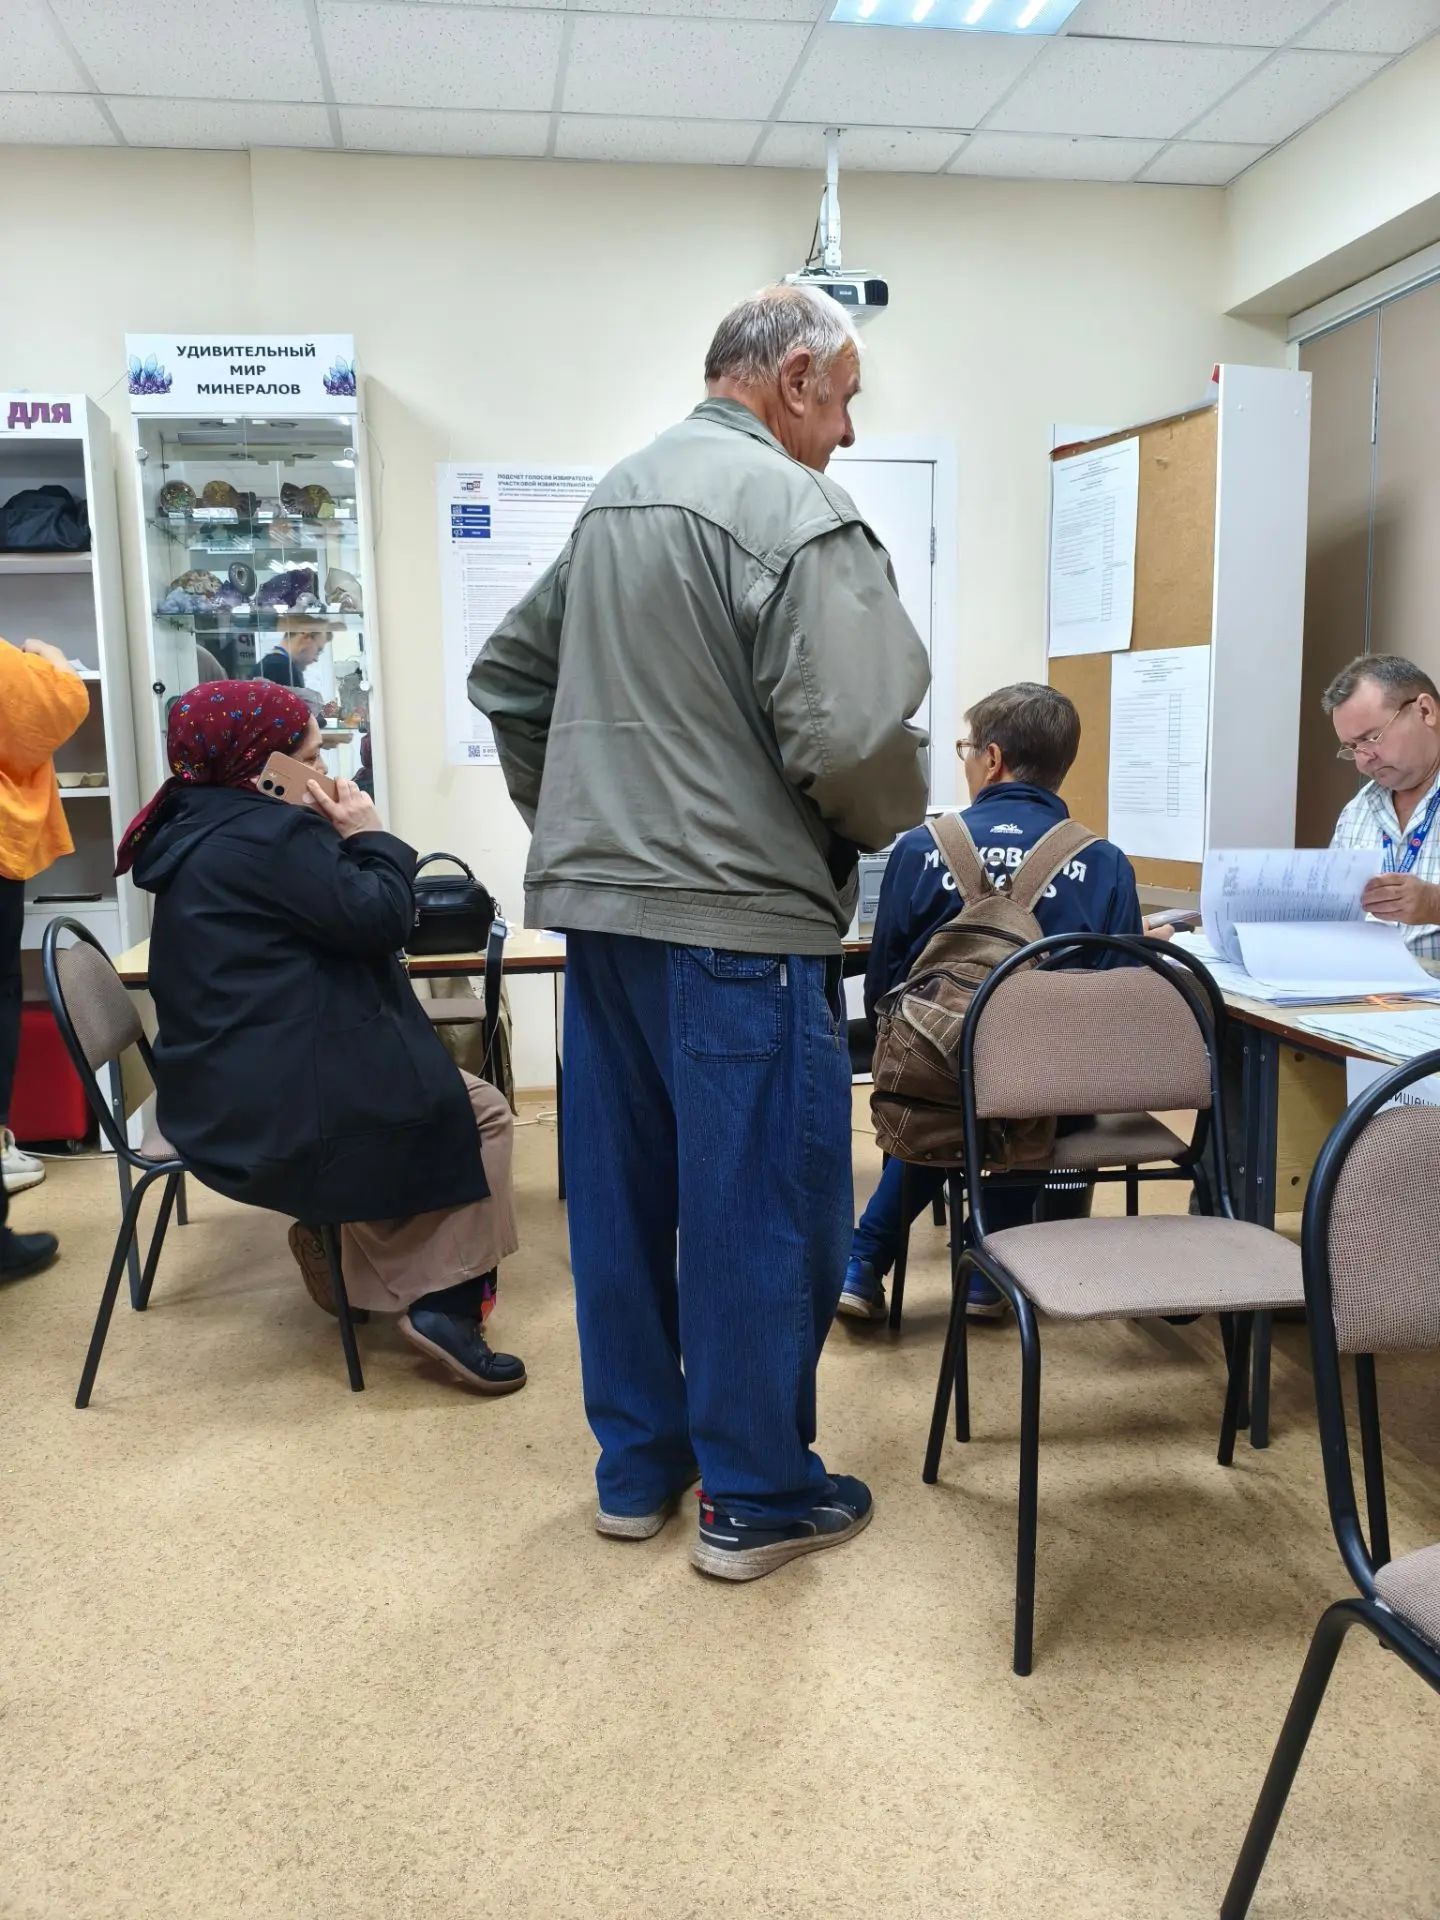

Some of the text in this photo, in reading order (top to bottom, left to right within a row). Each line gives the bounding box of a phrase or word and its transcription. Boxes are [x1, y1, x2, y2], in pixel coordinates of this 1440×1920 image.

[176, 343, 316, 359] УДИВИТЕЛЬНЫЙ
[230, 365, 266, 376] МИР
[197, 384, 301, 394] МИНЕРАЛОВ
[8, 402, 72, 429] ДЛЯ
